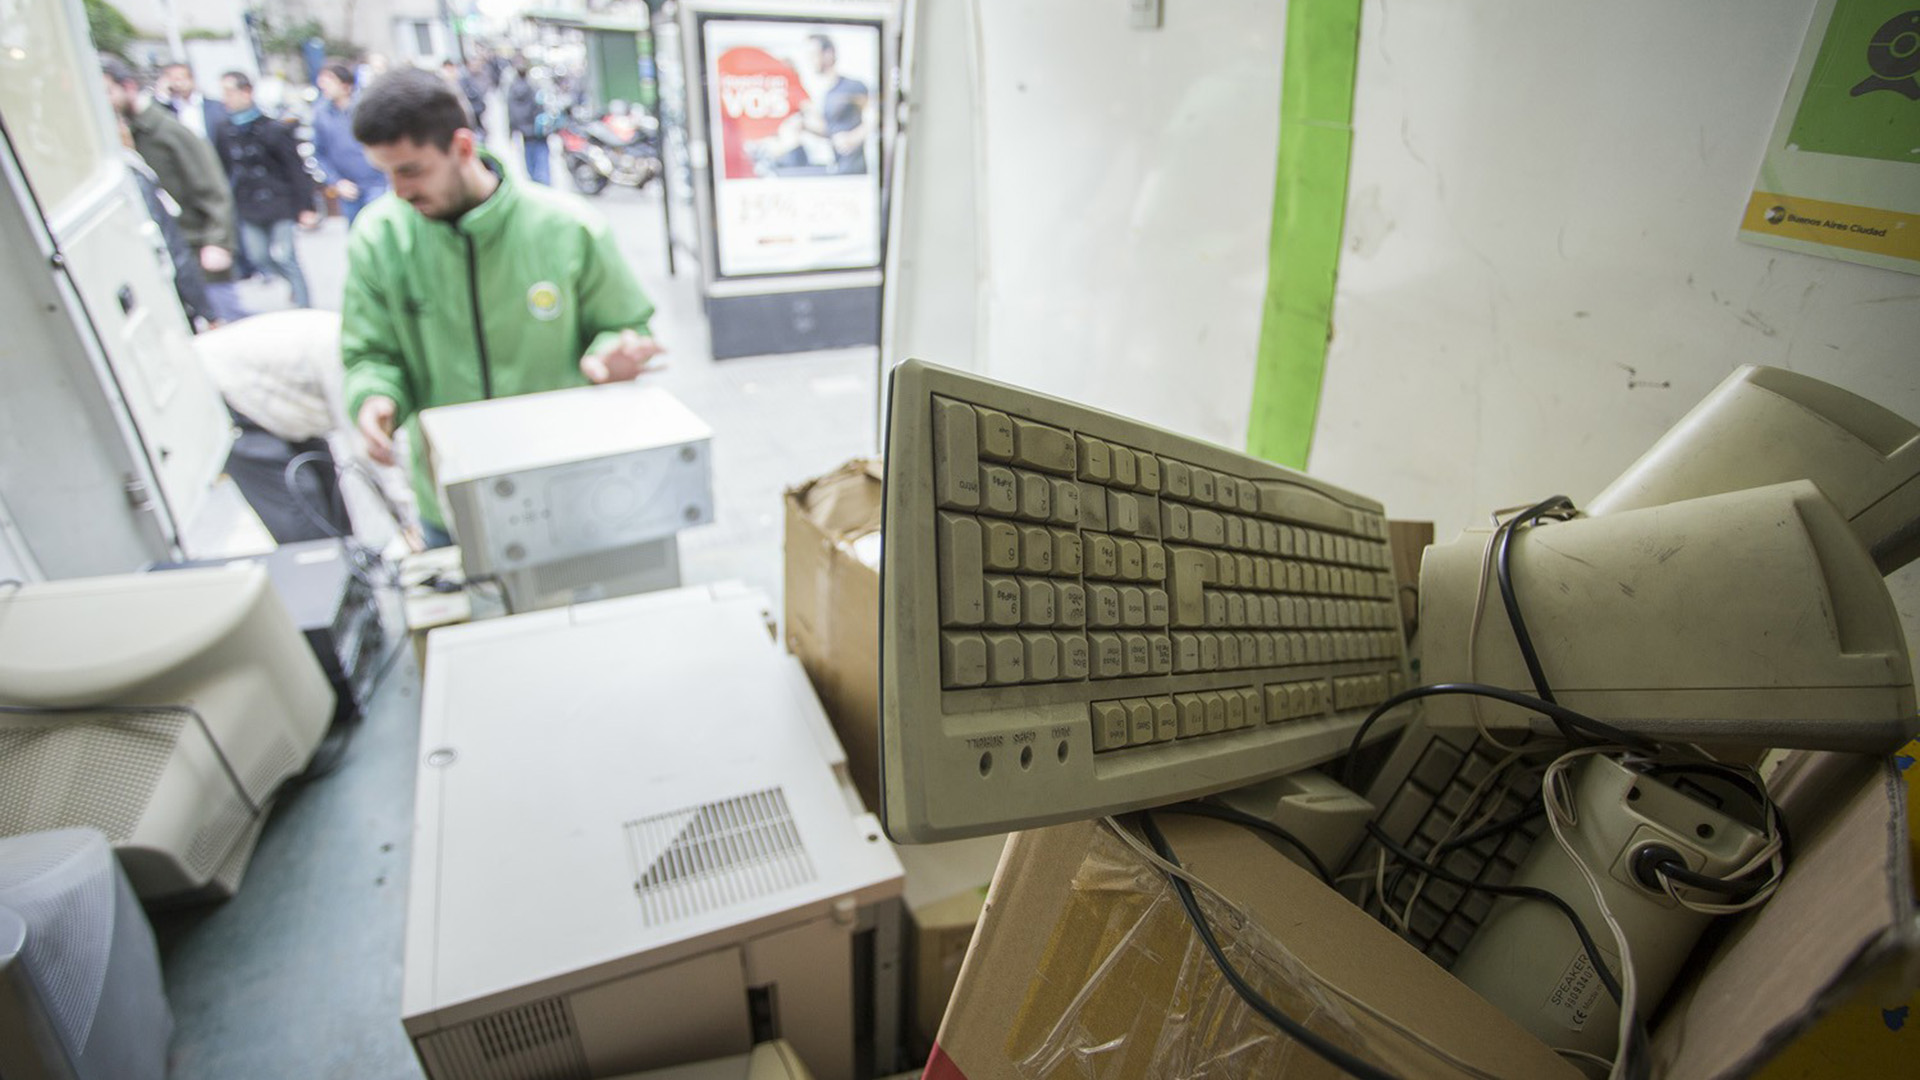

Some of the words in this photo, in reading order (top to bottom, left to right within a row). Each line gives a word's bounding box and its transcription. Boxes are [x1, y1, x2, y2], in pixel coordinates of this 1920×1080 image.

[722, 87, 789, 119] VOS
[1787, 214, 1821, 227] Buenos
[1823, 219, 1848, 231] Aires
[1850, 224, 1887, 237] Ciudad
[965, 735, 1003, 750] SCROLL
[1012, 730, 1036, 745] CAPS
[1551, 954, 1588, 1005] SPEAKER
